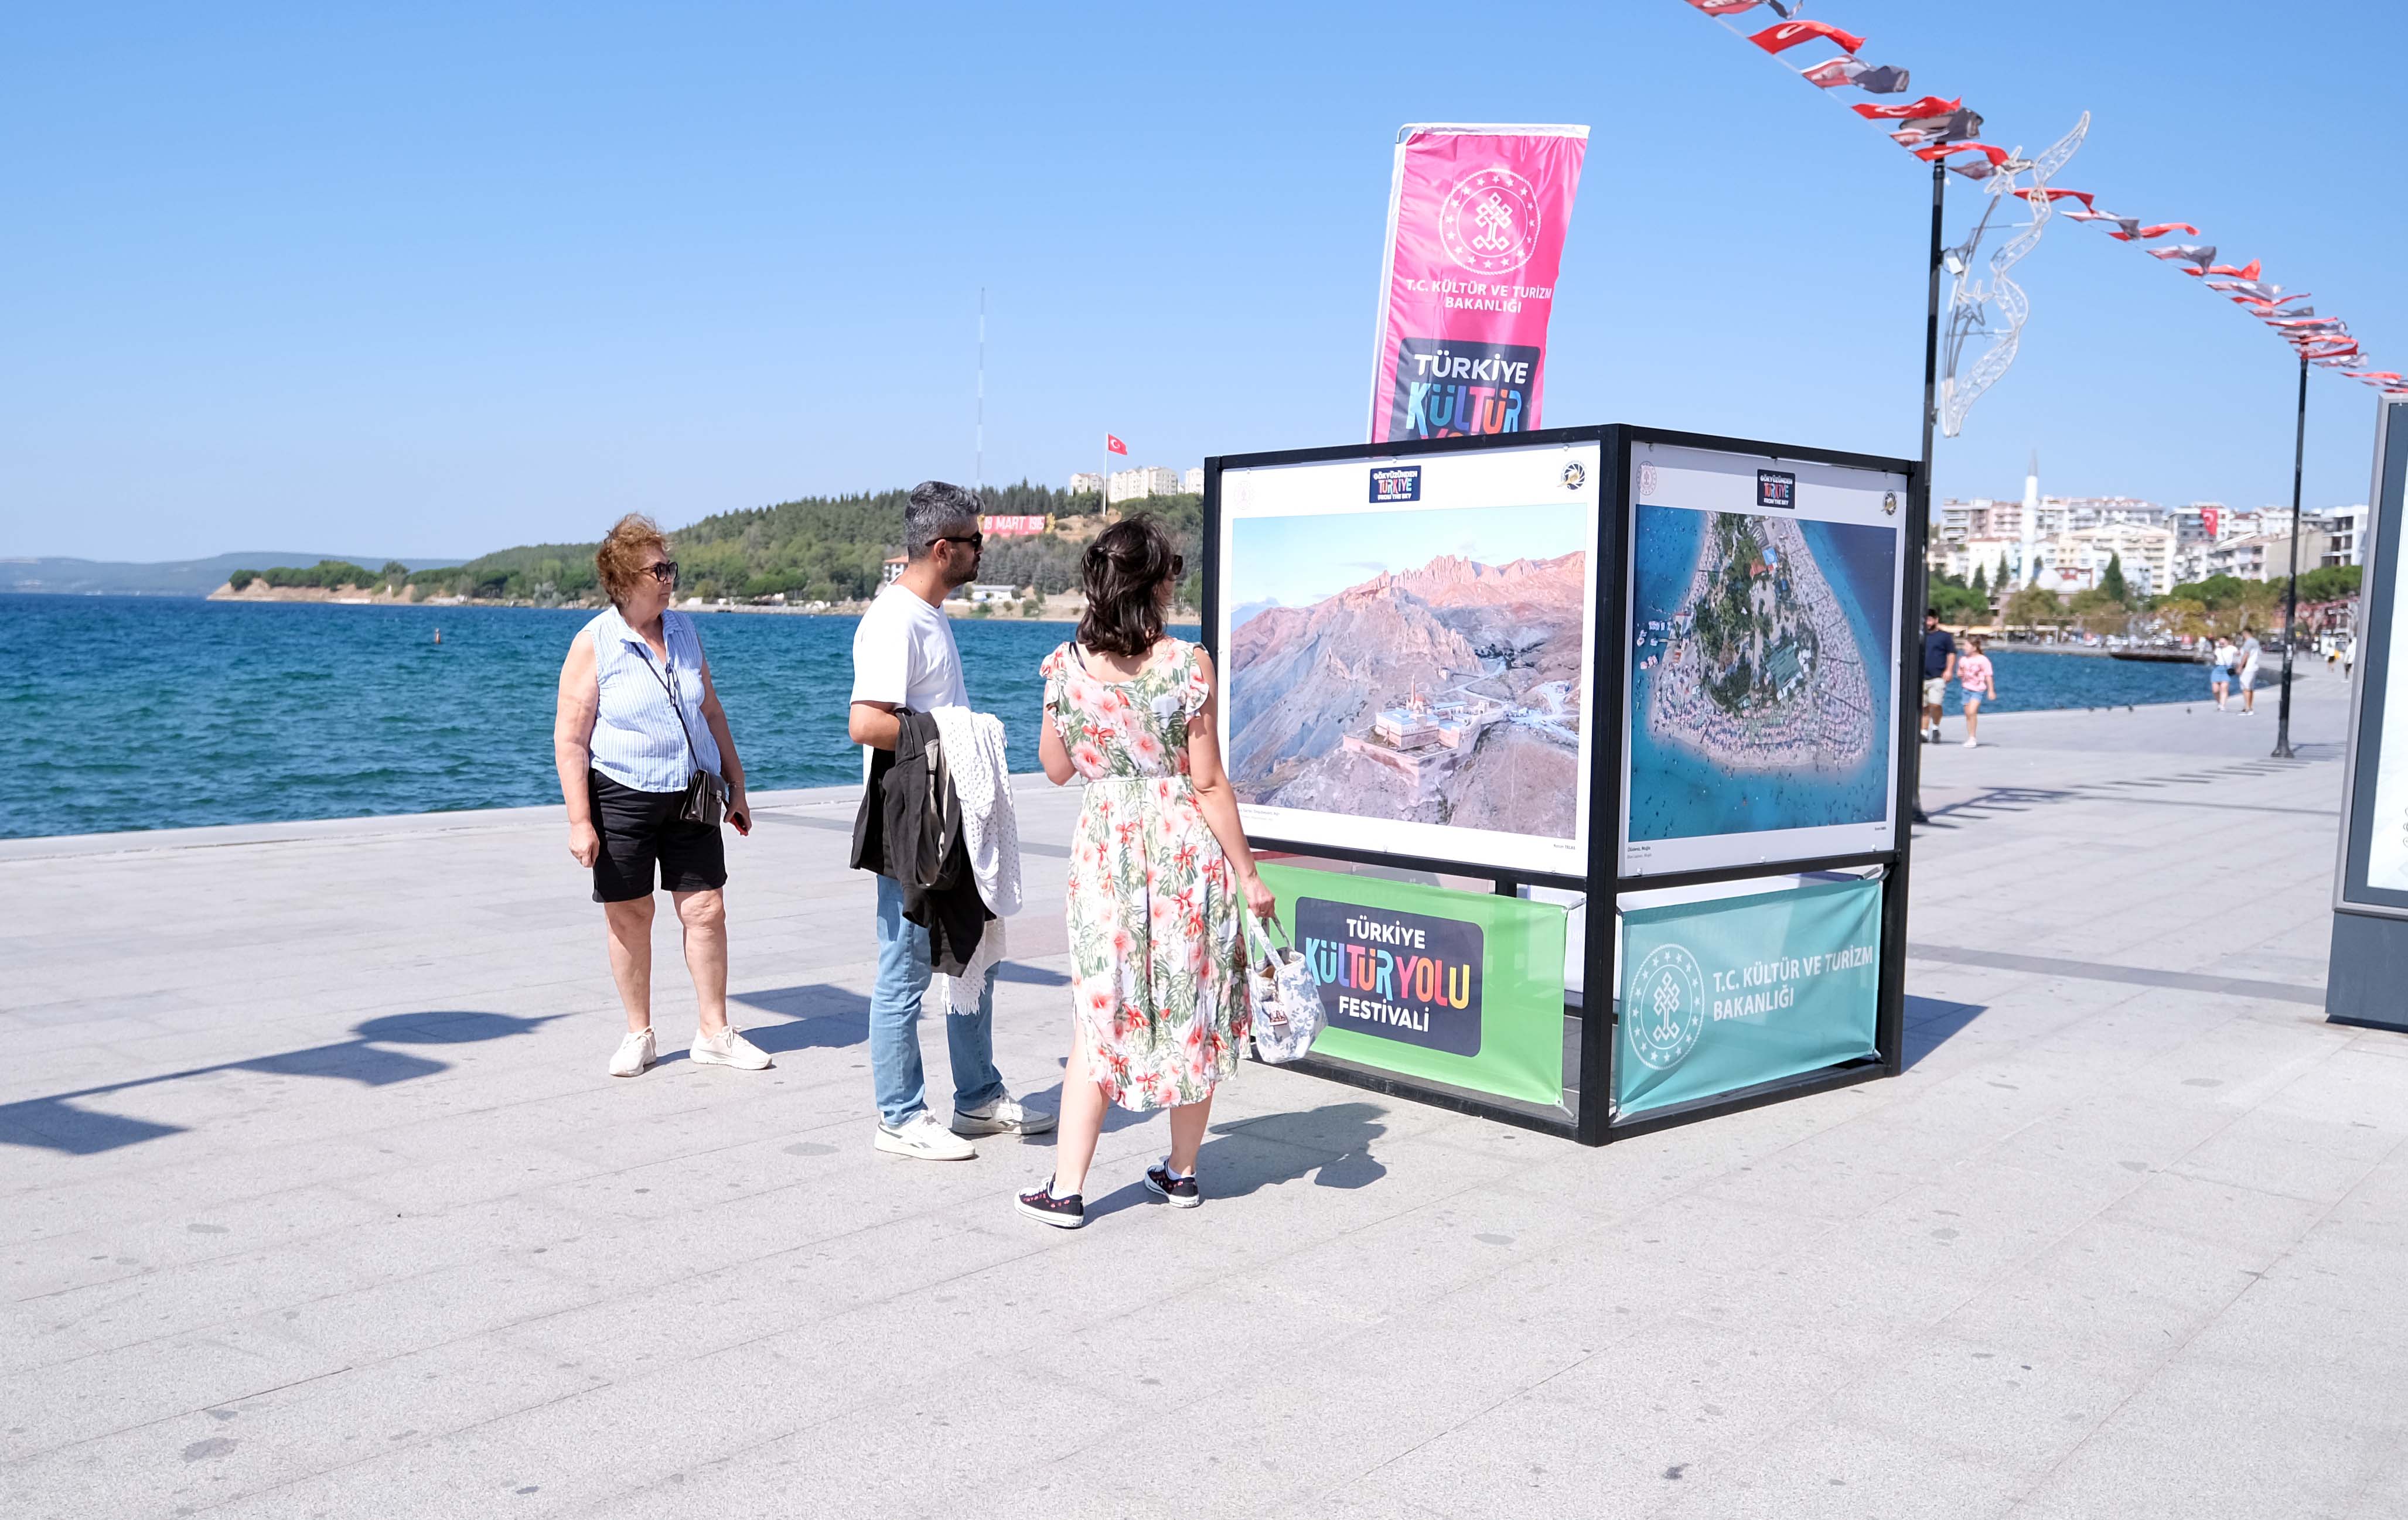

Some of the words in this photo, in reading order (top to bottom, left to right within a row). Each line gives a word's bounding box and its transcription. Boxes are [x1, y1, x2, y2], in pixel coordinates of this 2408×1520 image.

[1406, 279, 1428, 292] T.C.
[1432, 279, 1486, 295] KÜLTÜR
[1491, 285, 1507, 296] VE
[1445, 296, 1522, 313] BAKANLIĞI
[1414, 350, 1529, 384] TÜRKİYE
[1406, 381, 1522, 436] KÜLTÜR
[1379, 478, 1412, 494] TÜRKİYE
[1764, 483, 1789, 498] TÜRKİYE
[996, 516, 1026, 530] MART
[1346, 915, 1425, 949] TÜRKİYE
[1305, 937, 1394, 1001] KÜLTÜR
[1396, 955, 1470, 1009] YOLU
[1713, 970, 1739, 992] T.C.
[1743, 957, 1799, 988] KÜLTÜR
[1803, 955, 1822, 976] VE
[1826, 945, 1872, 972] TURİZM
[1339, 996, 1429, 1032] FESTİVALİ
[1713, 985, 1794, 1022] BAKANLIĞI
